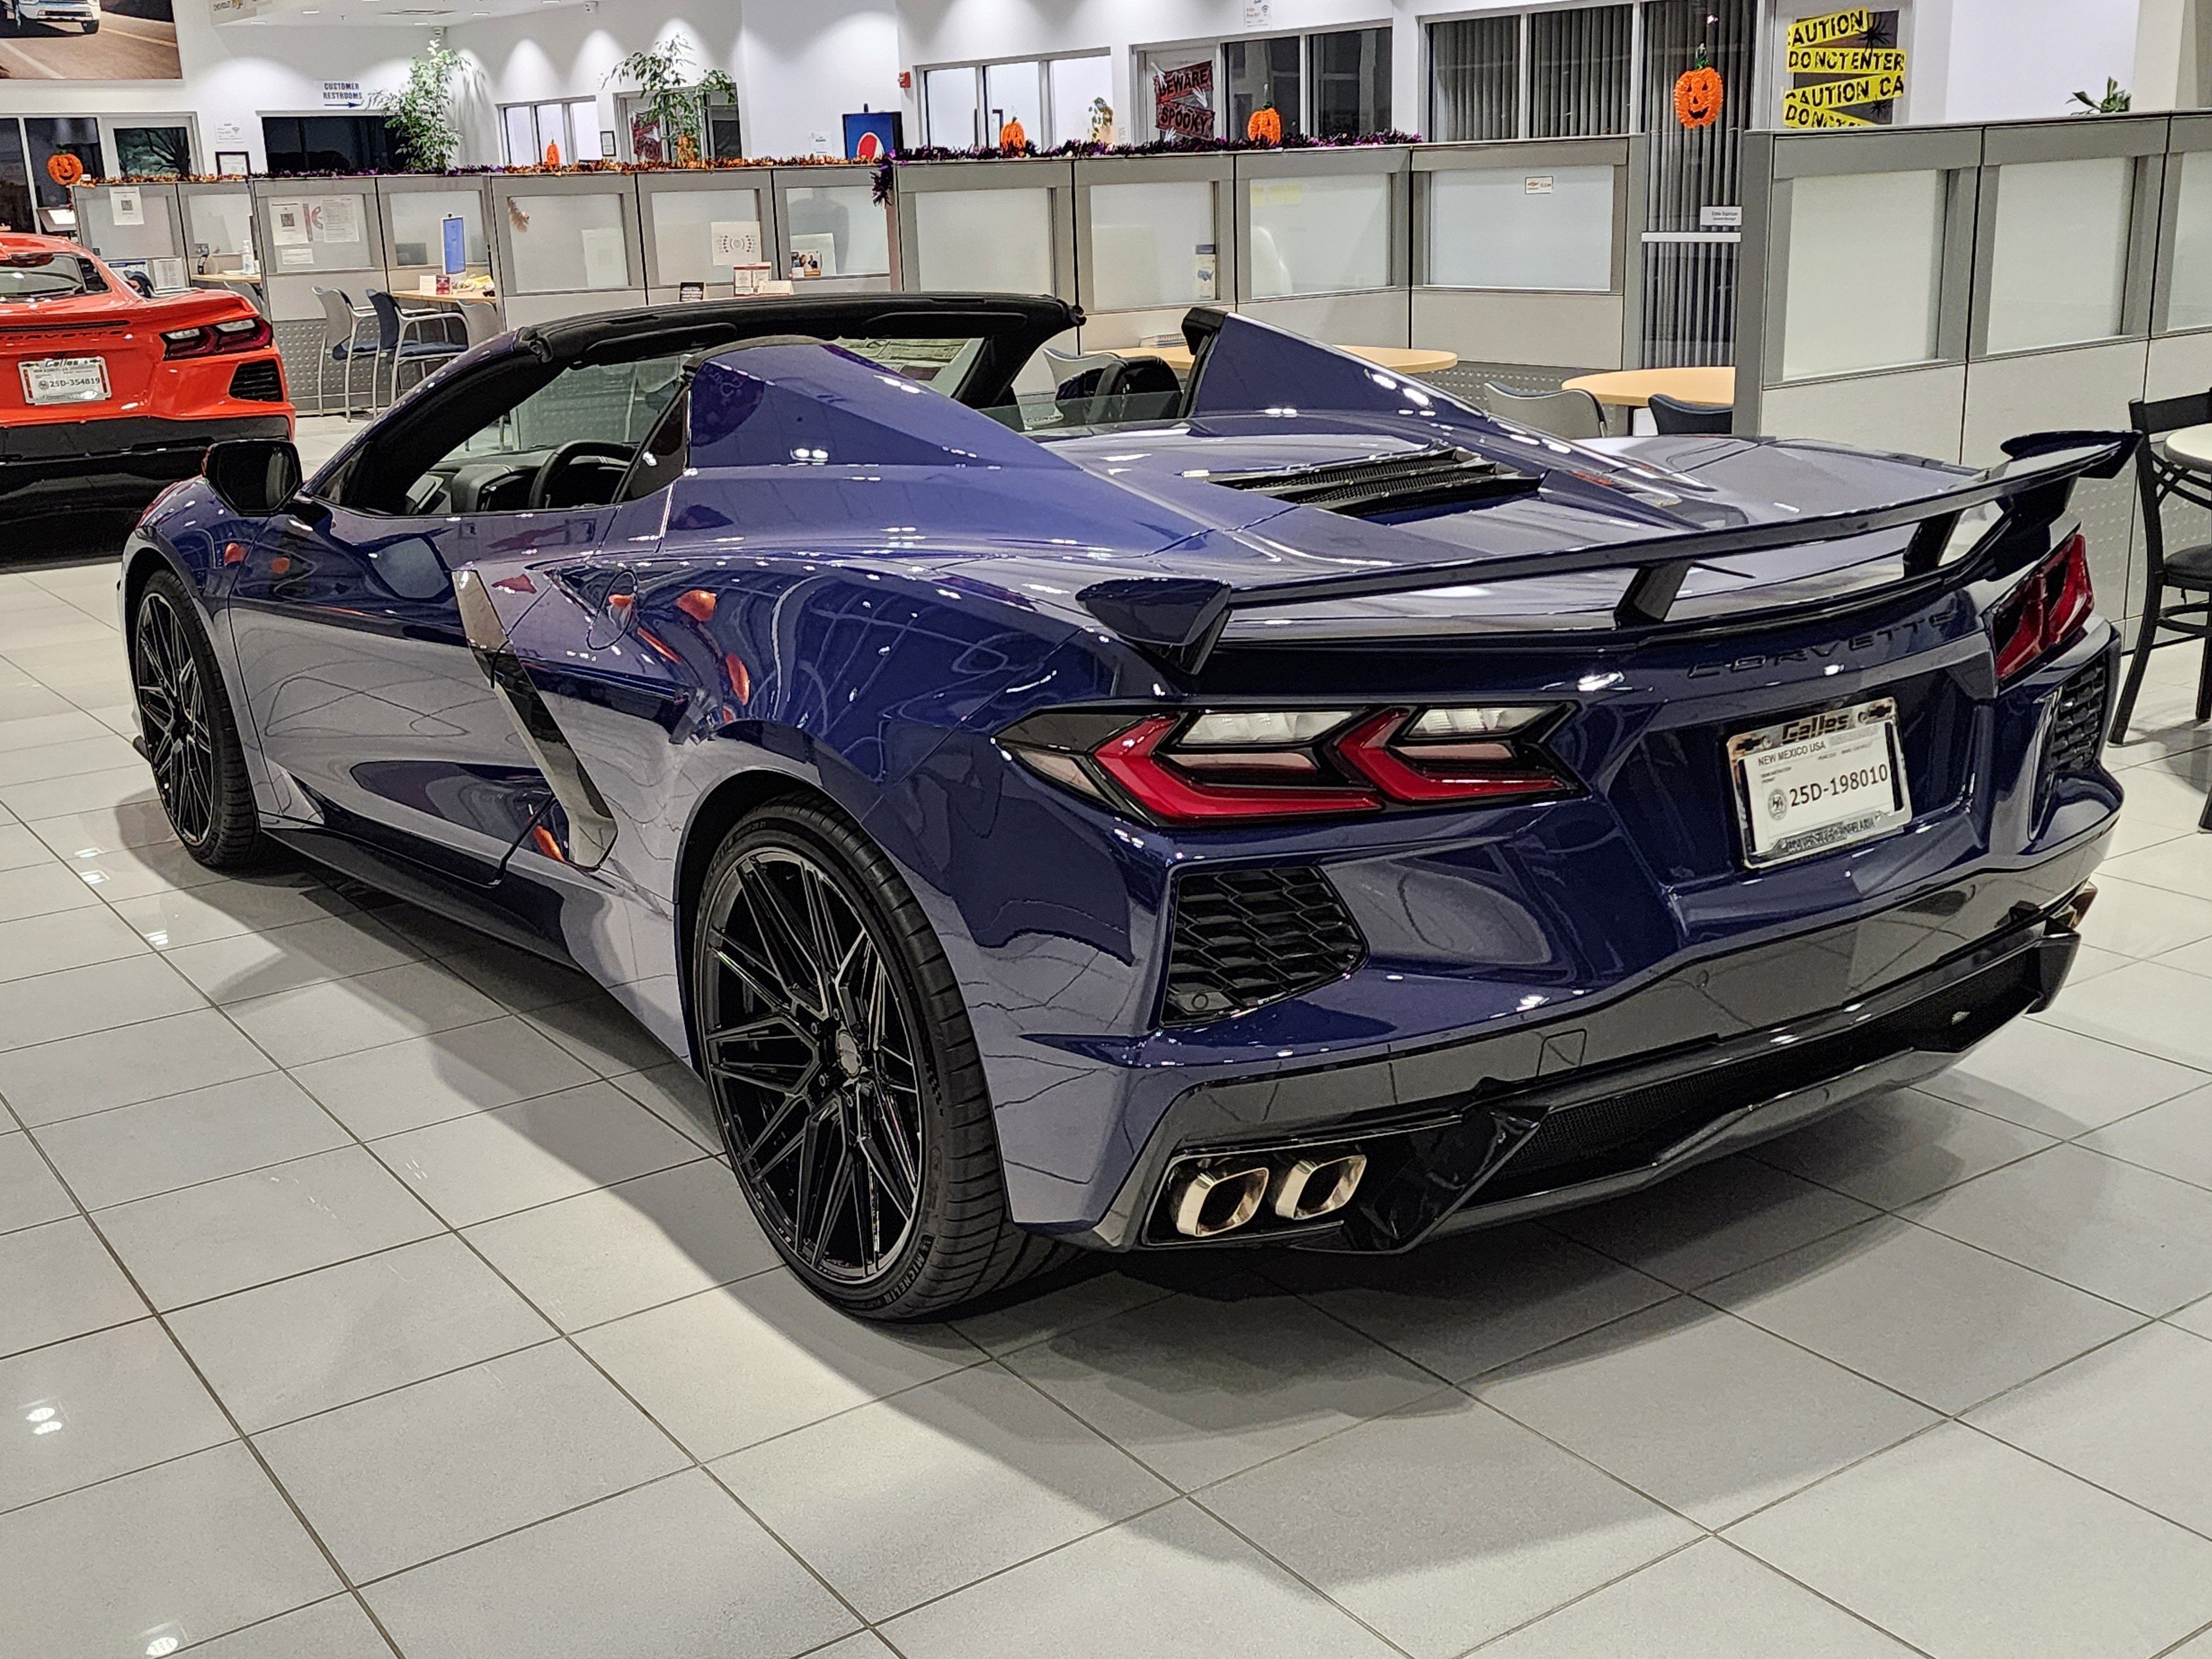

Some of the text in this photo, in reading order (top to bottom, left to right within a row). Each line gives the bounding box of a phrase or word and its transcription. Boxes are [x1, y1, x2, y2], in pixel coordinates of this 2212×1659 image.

[1788, 10, 1864, 46] AUTION
[1789, 51, 1904, 71] DO NOT ENTER
[1161, 106, 1208, 134] SPOOKY
[1786, 104, 1810, 126] DO
[1688, 609, 1955, 678] CORVETTE
[1781, 714, 1849, 745] Galles
[1757, 754, 1776, 766] NEW
[1778, 745, 1808, 761] MEXICO
[1810, 740, 1827, 753] USA
[1790, 764, 1888, 807] 25D-198010
[884, 1253, 925, 1304] MICHELIN
